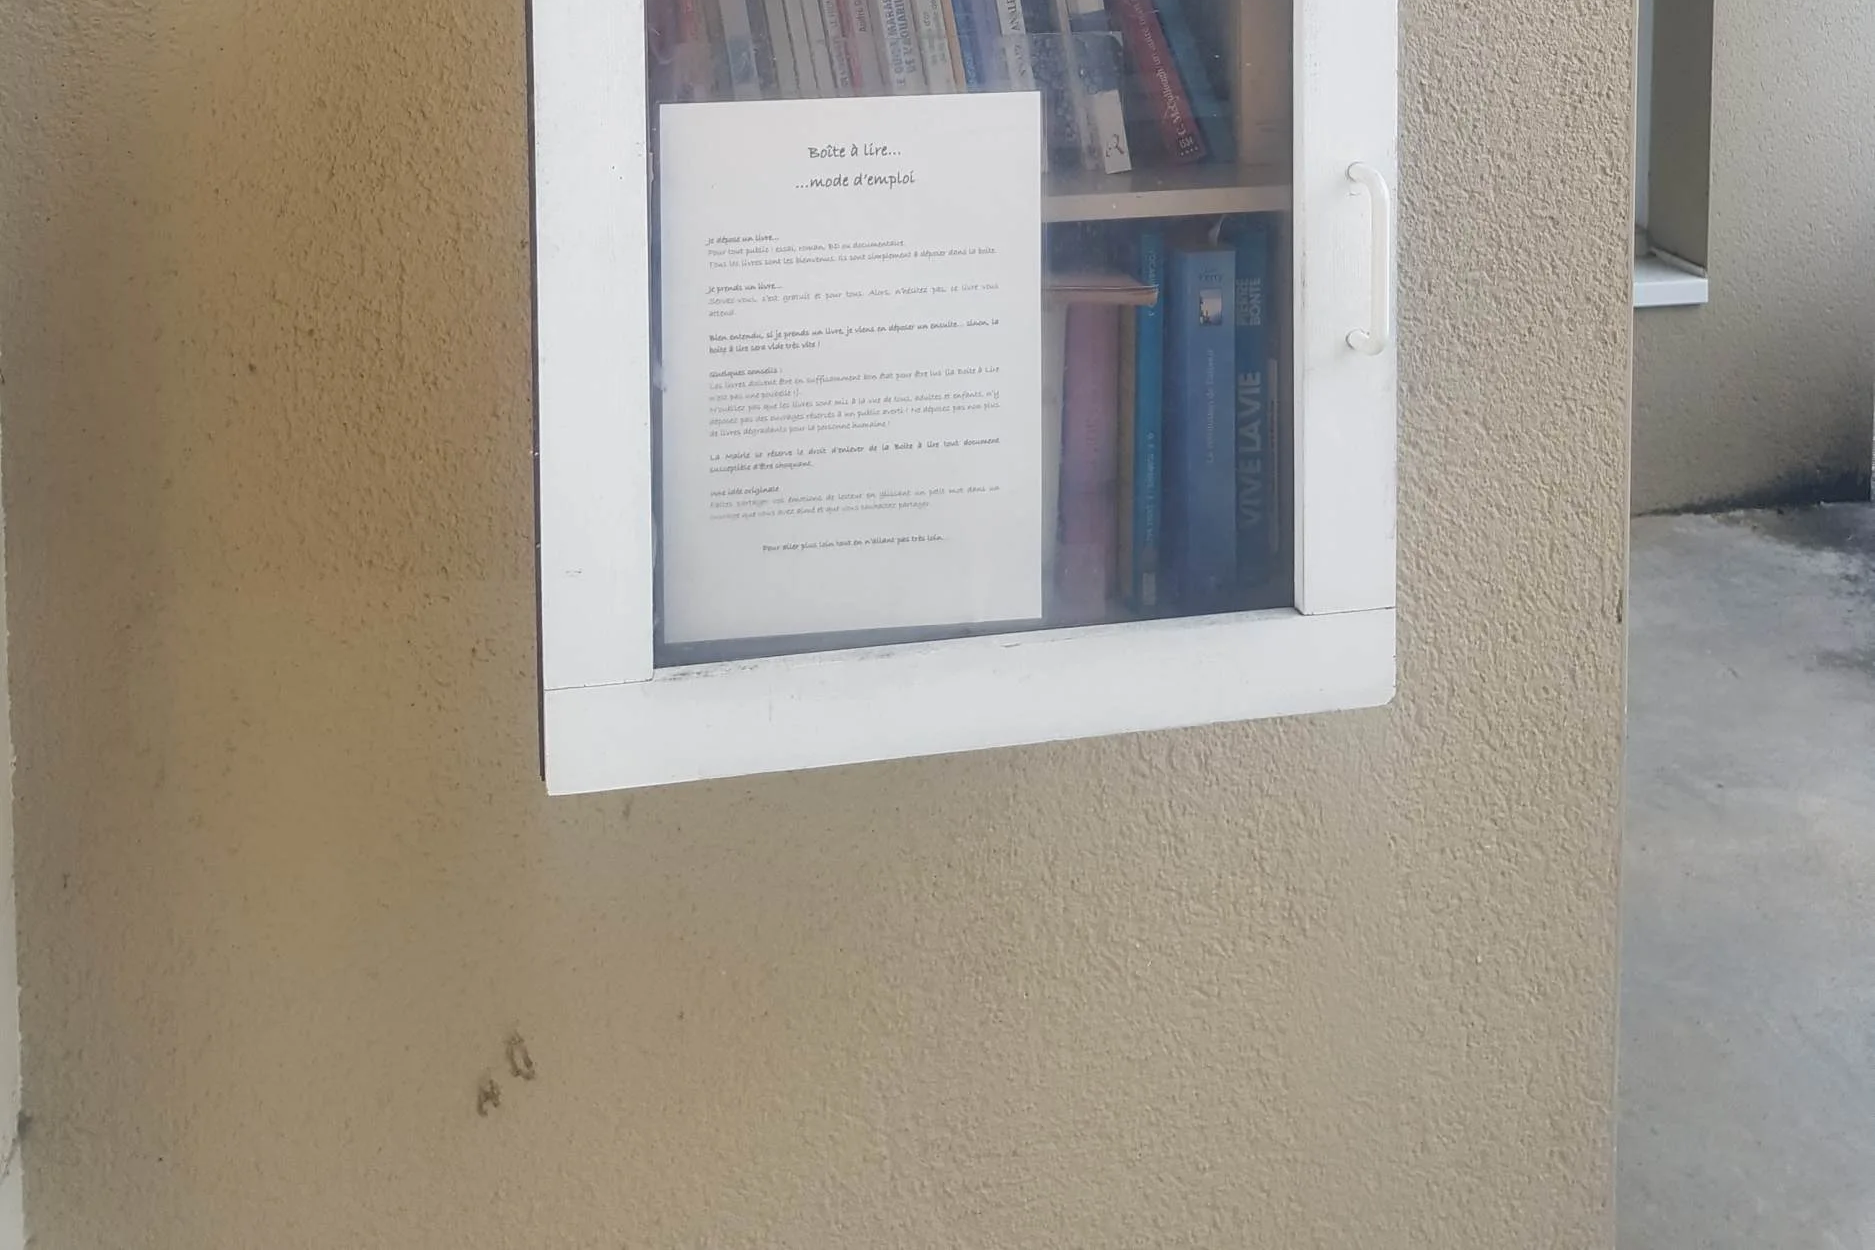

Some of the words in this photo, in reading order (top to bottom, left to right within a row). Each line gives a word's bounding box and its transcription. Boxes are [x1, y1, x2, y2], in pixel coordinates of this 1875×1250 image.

[807, 144, 846, 159] Boîte
[850, 142, 859, 157] à
[853, 170, 916, 190] d'emploi
[1248, 277, 1262, 326] BONTE
[1238, 371, 1262, 418] VIE
[1238, 419, 1262, 452] LA
[1238, 459, 1263, 528] VIVE
